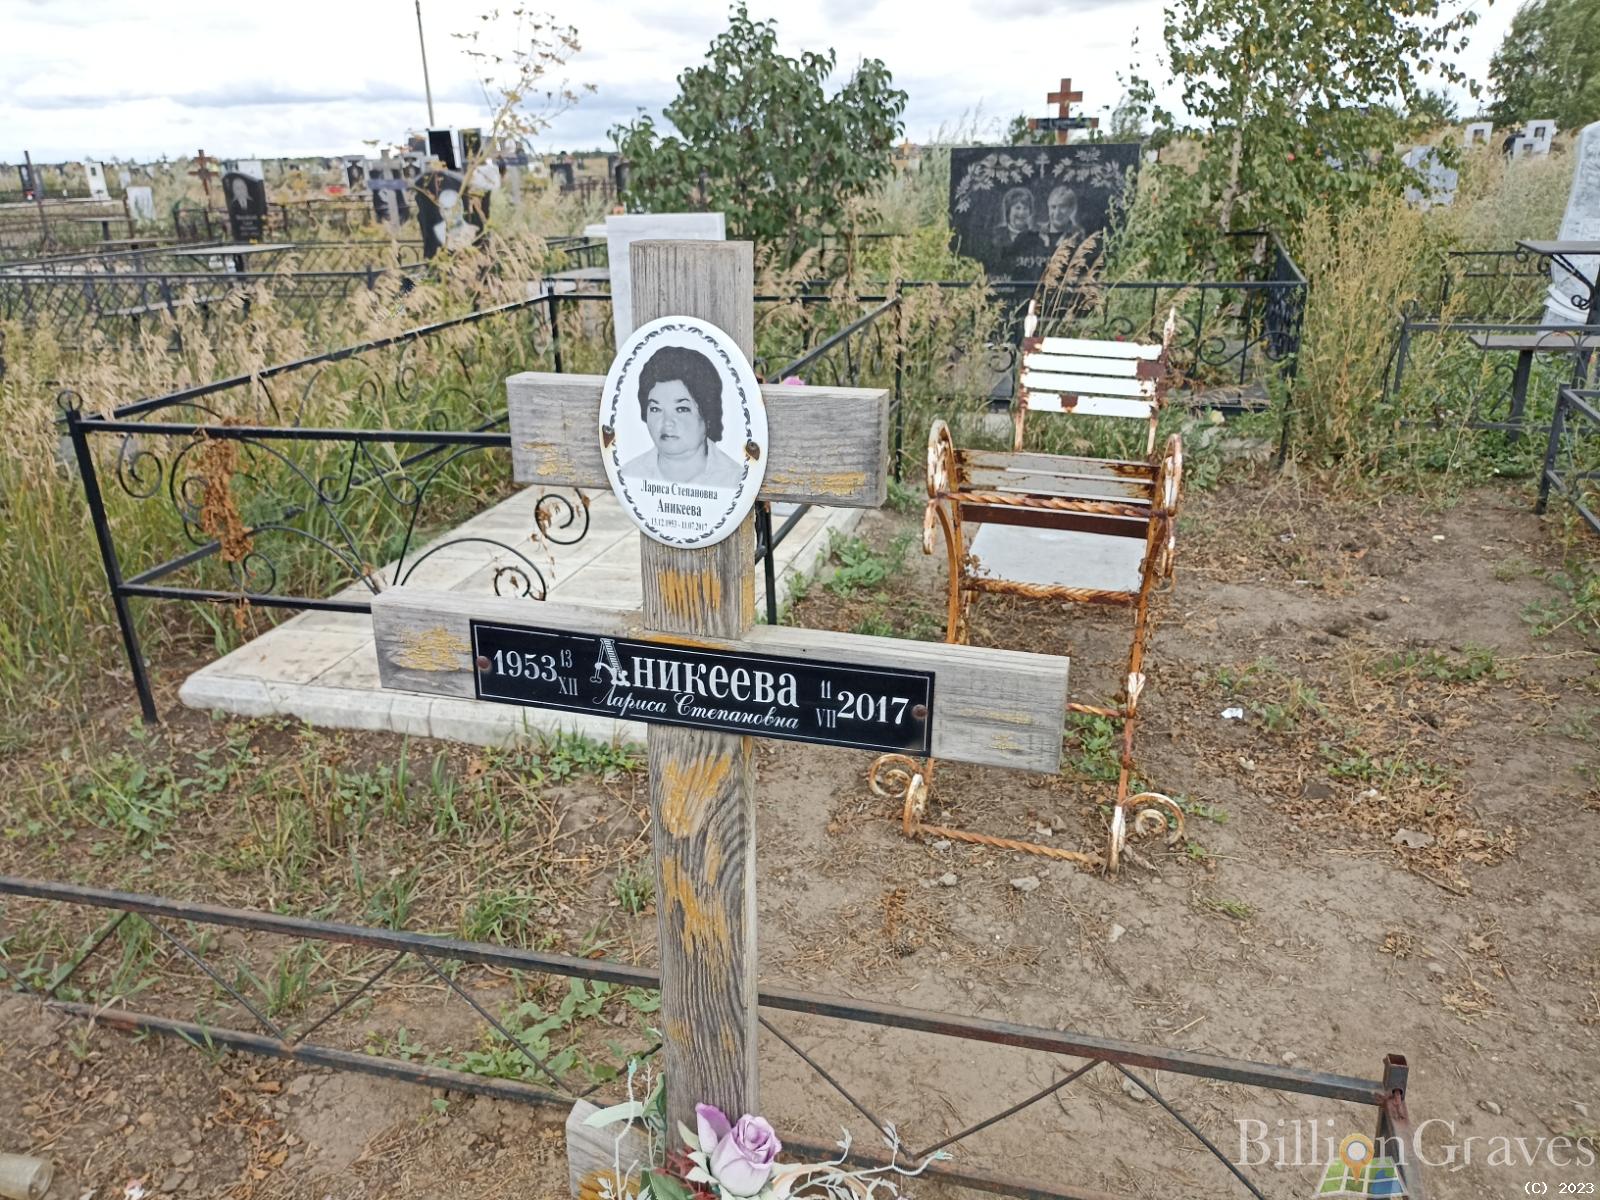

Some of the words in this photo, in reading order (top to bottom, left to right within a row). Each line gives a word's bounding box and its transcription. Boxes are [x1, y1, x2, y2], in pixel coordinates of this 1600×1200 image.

[641, 480, 669, 496] Лариса
[672, 483, 718, 499] Степановна
[657, 499, 701, 516] Аникеева
[493, 650, 557, 682] 1953
[560, 649, 573, 668] 13
[590, 638, 799, 708] Аникеева
[558, 676, 579, 696] XII
[820, 680, 831, 699] 11
[593, 687, 667, 716] Лариса
[673, 692, 799, 729] Степановна
[836, 690, 910, 725] 2017
[816, 708, 837, 728] VII
